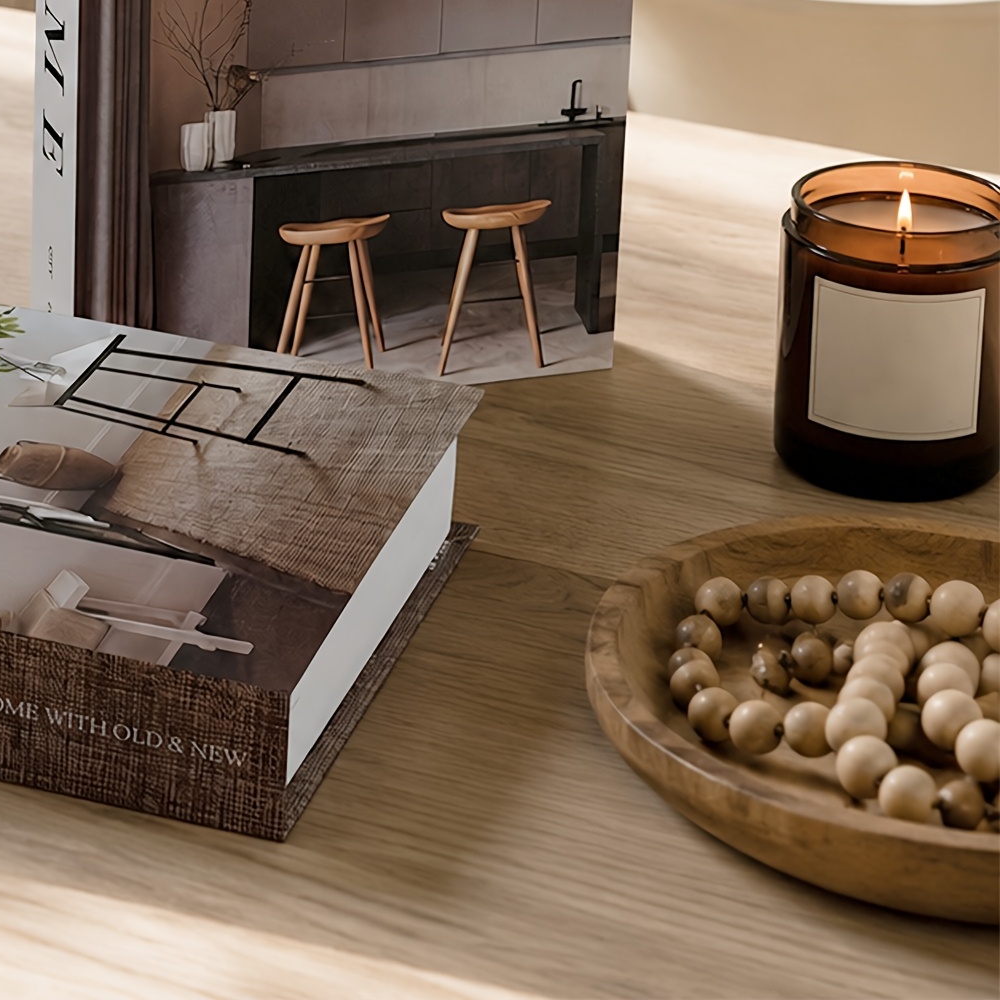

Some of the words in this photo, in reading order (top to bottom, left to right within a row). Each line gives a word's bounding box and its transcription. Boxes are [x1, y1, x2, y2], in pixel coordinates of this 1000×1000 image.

[45, 707, 107, 737] WITH
[112, 723, 163, 749] OLD
[167, 735, 184, 755] &
[189, 740, 248, 767] NEW
